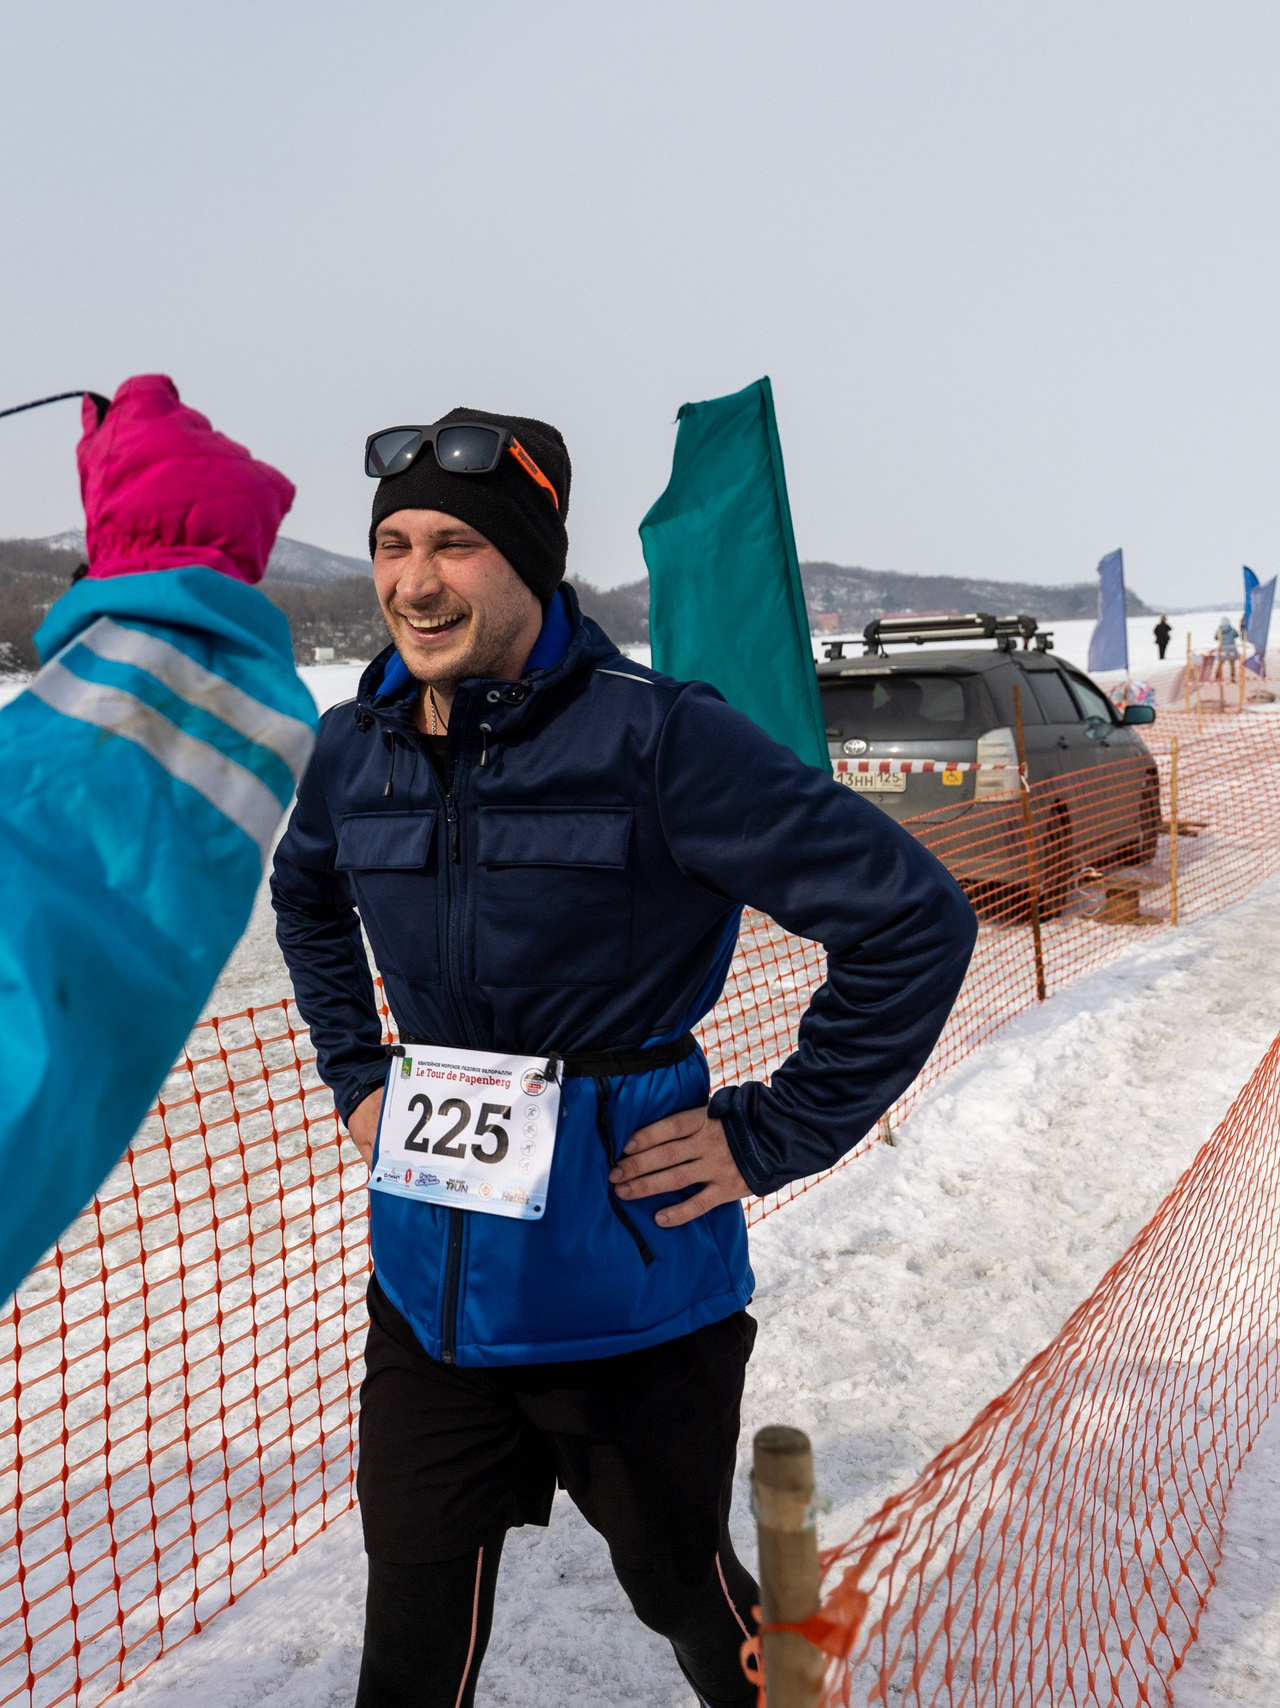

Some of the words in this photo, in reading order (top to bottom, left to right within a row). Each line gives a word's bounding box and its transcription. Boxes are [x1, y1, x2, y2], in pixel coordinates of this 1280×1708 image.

[416, 1067, 424, 1077] Le
[426, 1068, 445, 1079] Tour
[446, 1070, 457, 1081] de
[459, 1072, 511, 1089] Papenberg
[404, 1093, 512, 1164] 225
[501, 1192, 531, 1205] Helios
